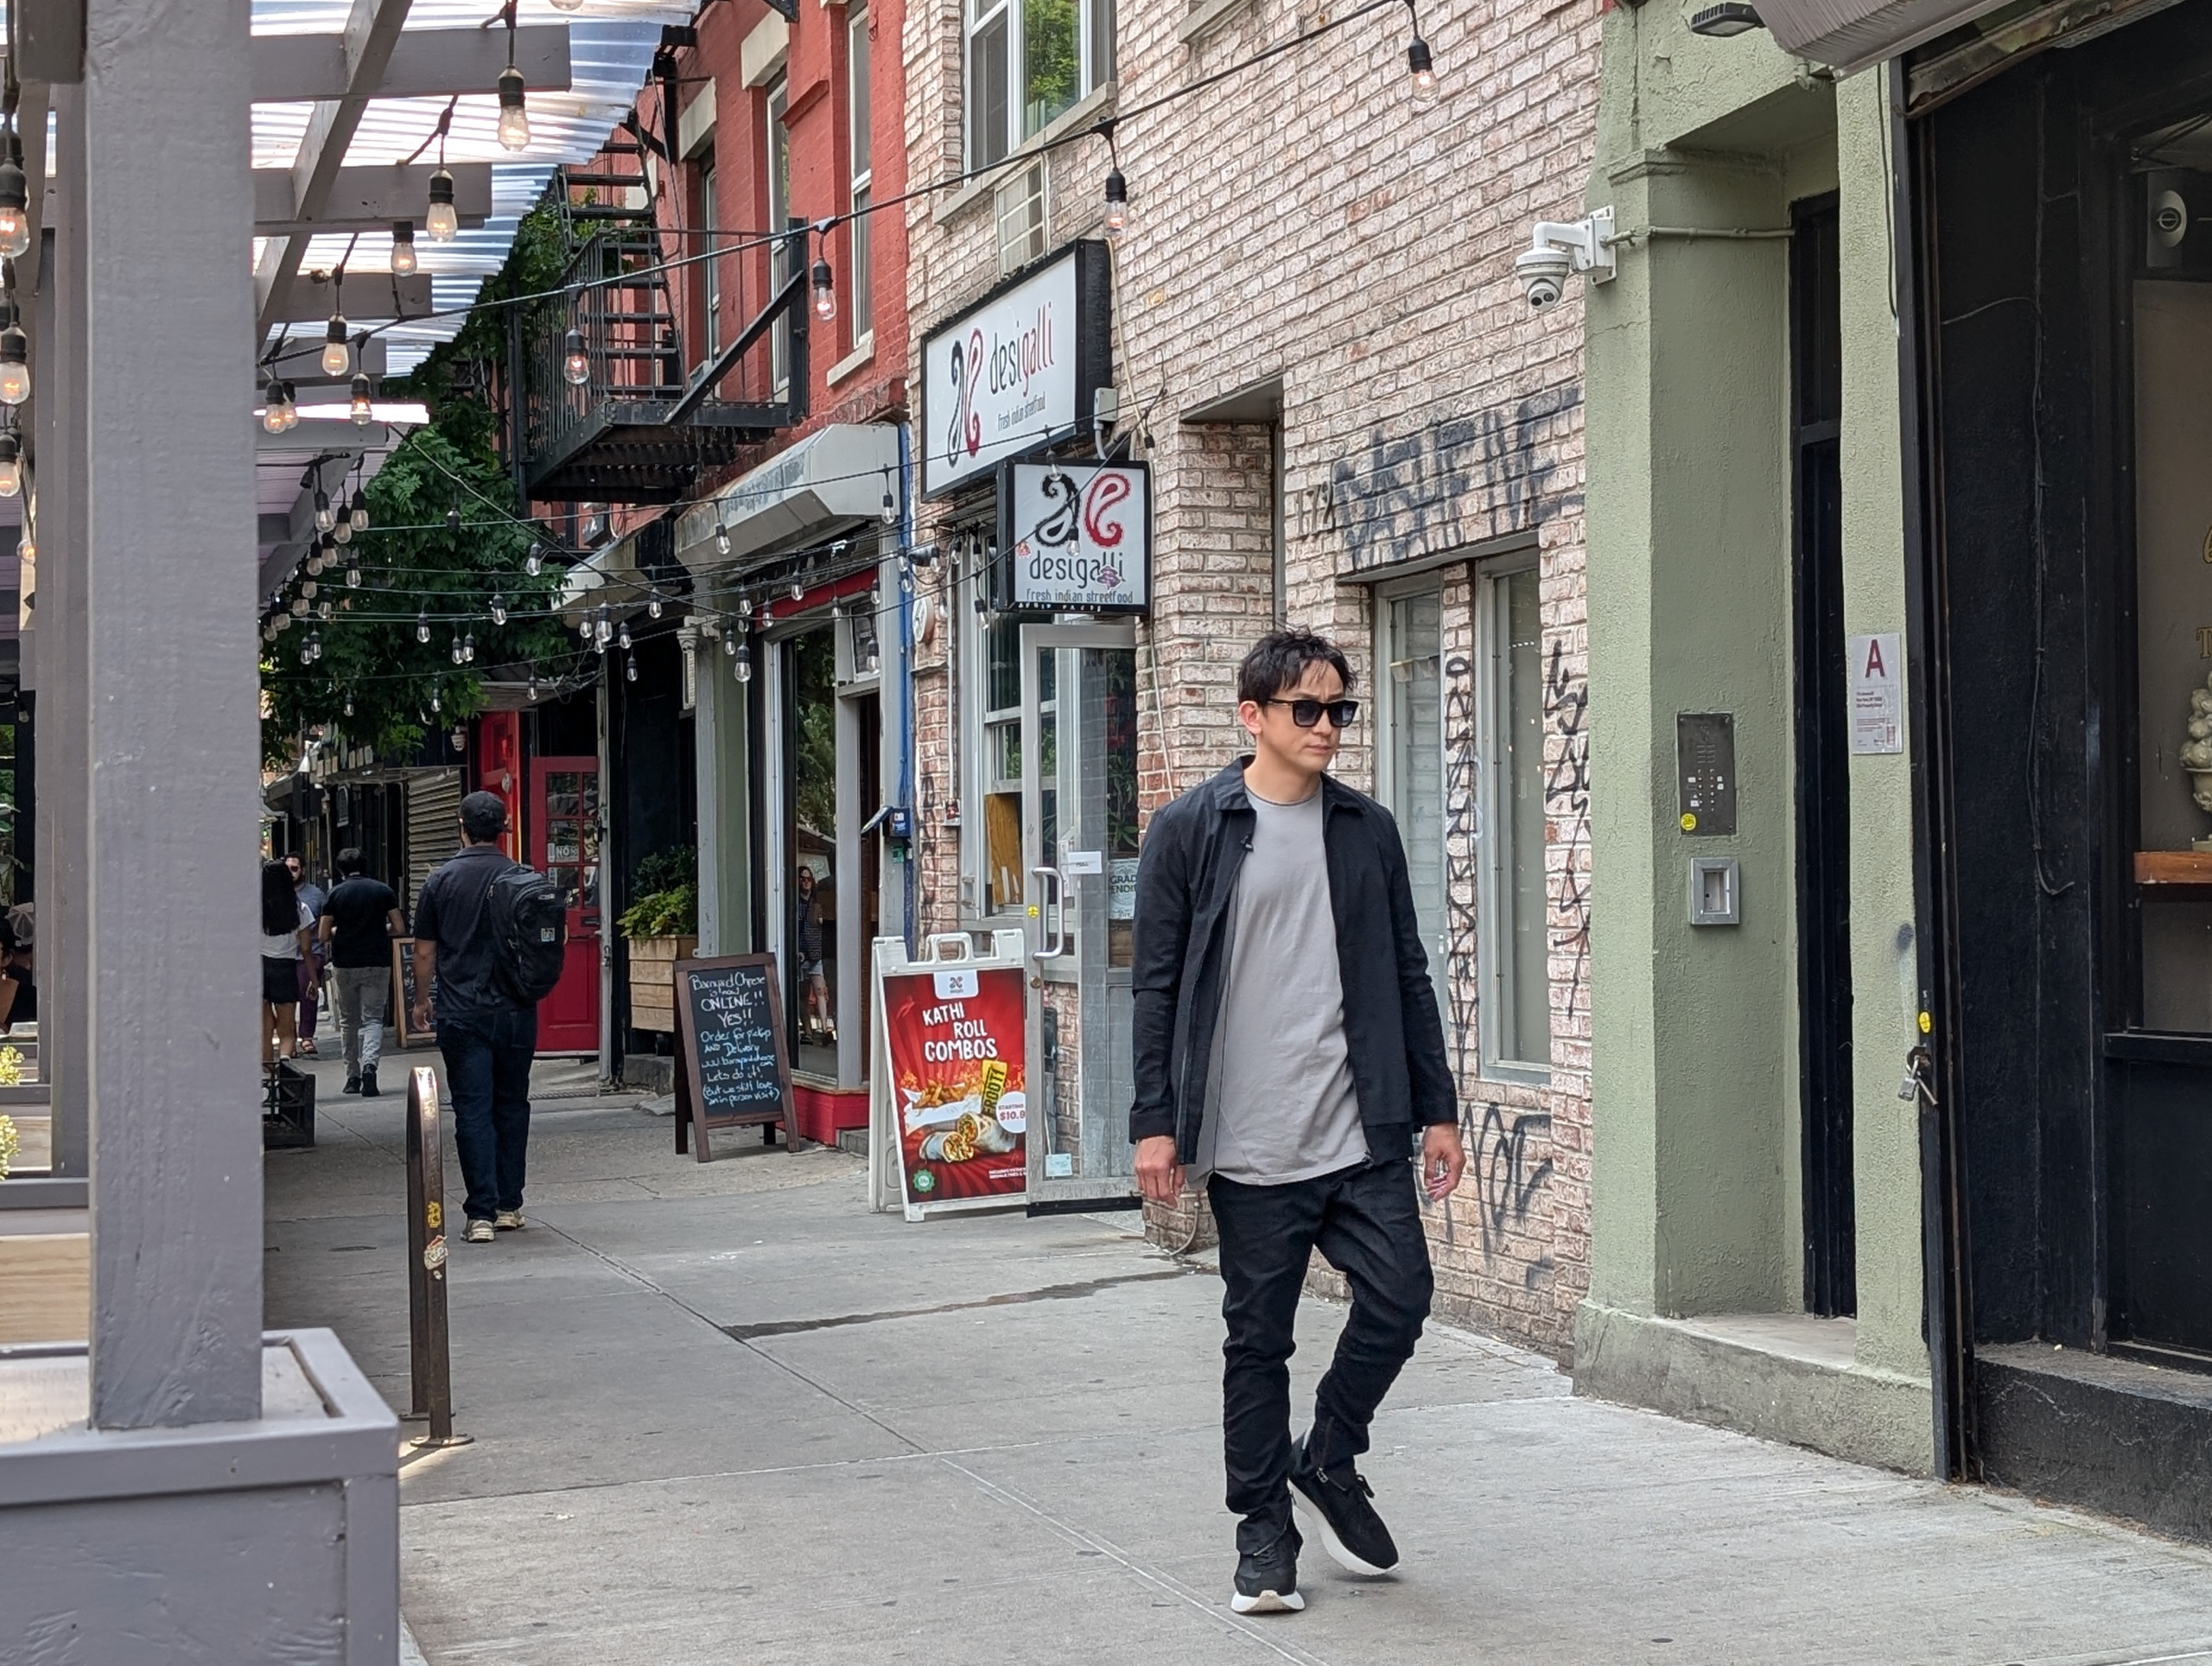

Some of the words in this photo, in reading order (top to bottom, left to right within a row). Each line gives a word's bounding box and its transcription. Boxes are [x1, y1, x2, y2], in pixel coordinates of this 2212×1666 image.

[990, 301, 1054, 397] desigalli
[998, 410, 1010, 431] fresh
[1011, 405, 1024, 425] indian
[1025, 391, 1046, 419] streetfood
[1029, 550, 1126, 589] desigalli
[1027, 588, 1052, 601] fresh
[1055, 589, 1083, 602] indian
[1086, 590, 1134, 603] streetfood
[1865, 639, 1885, 678] A
[1109, 874, 1137, 885] GRAD
[717, 1008, 753, 1027] YES!!
[923, 1002, 965, 1026] KATHI
[701, 1029, 729, 1043] Order
[954, 1019, 987, 1040] ROLL
[925, 1038, 998, 1062] COMBOS
[729, 1094, 753, 1108] person
[1000, 1110, 1027, 1122] $10.9
